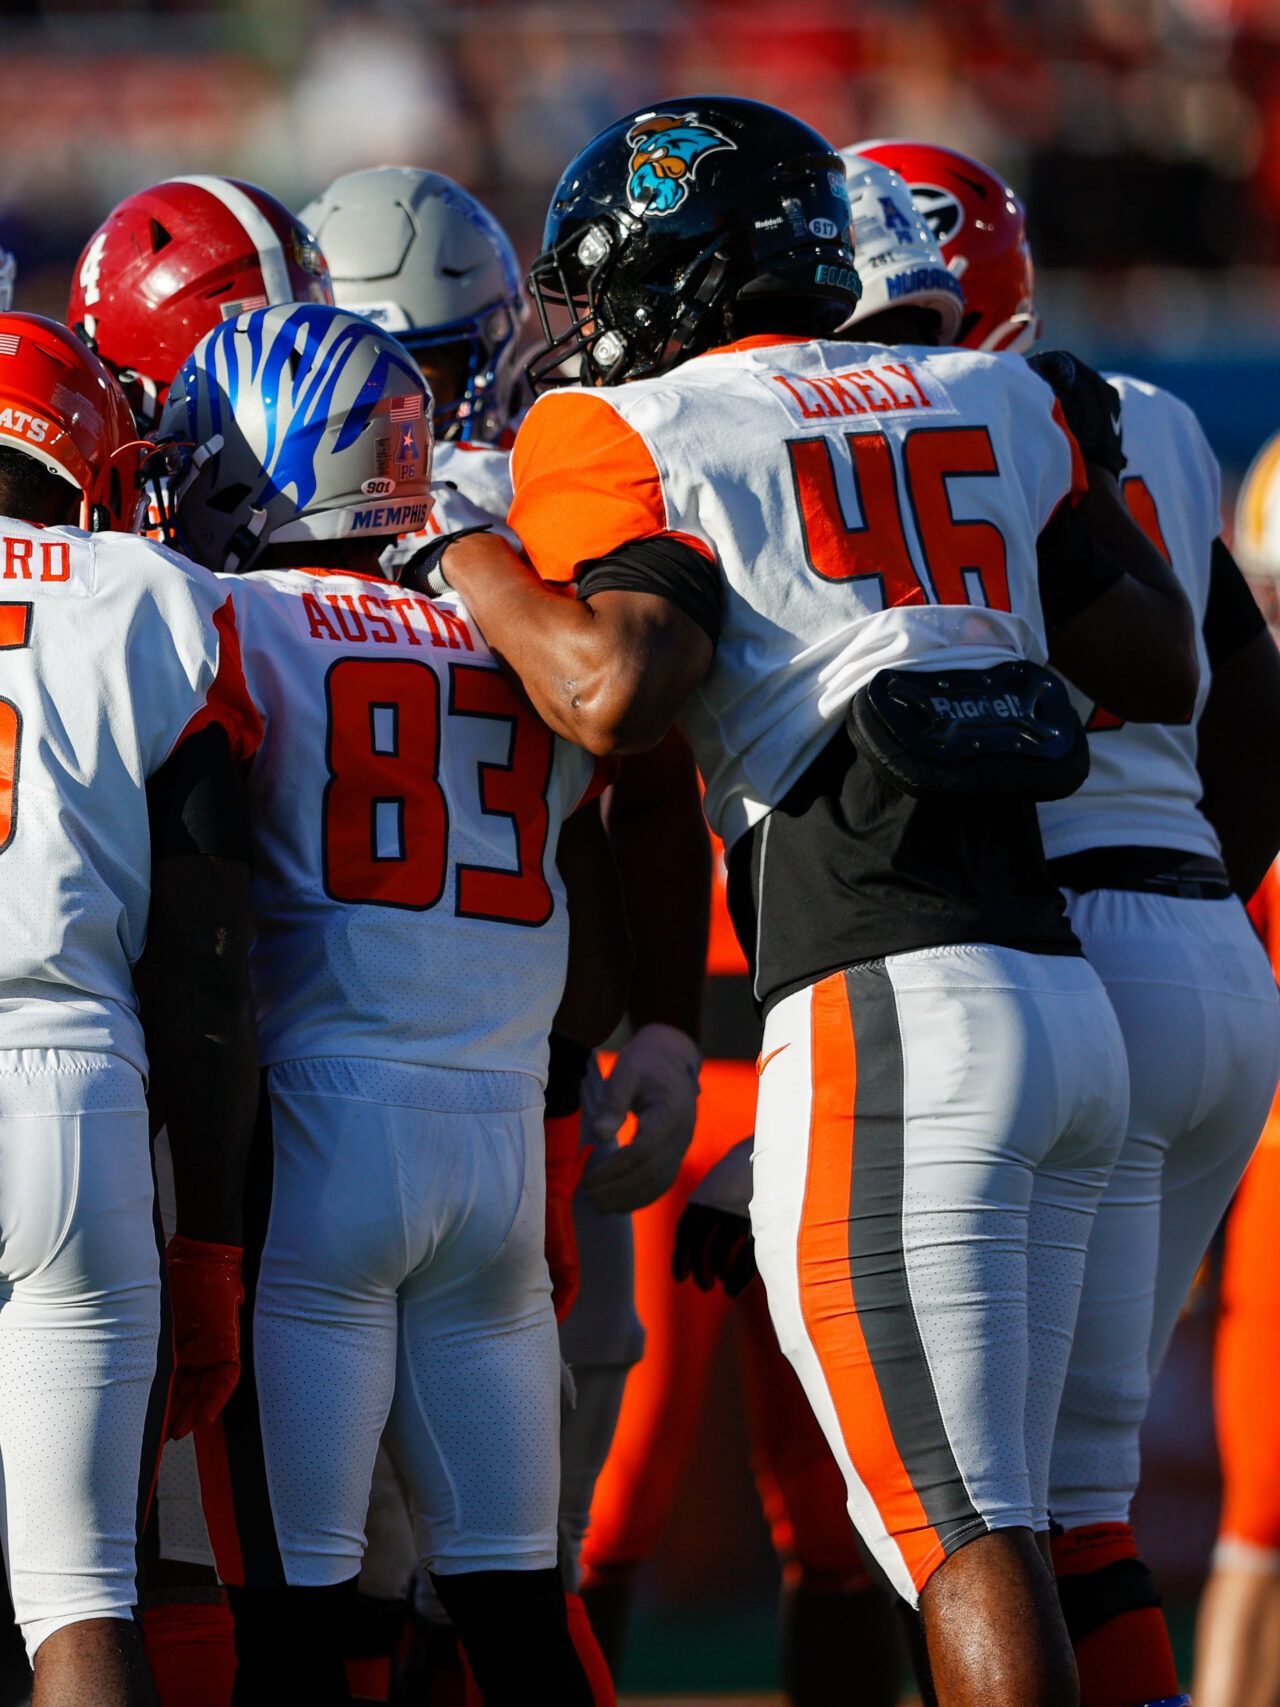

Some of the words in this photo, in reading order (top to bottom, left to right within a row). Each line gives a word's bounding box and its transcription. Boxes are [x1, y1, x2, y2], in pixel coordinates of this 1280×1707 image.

[813, 221, 834, 237] 617
[773, 363, 933, 419] LIKELY
[366, 480, 392, 495] 901
[351, 503, 428, 532] MEMPHIS
[784, 425, 1013, 612] 46
[301, 591, 476, 652] AUSTIN
[320, 656, 556, 928] 83
